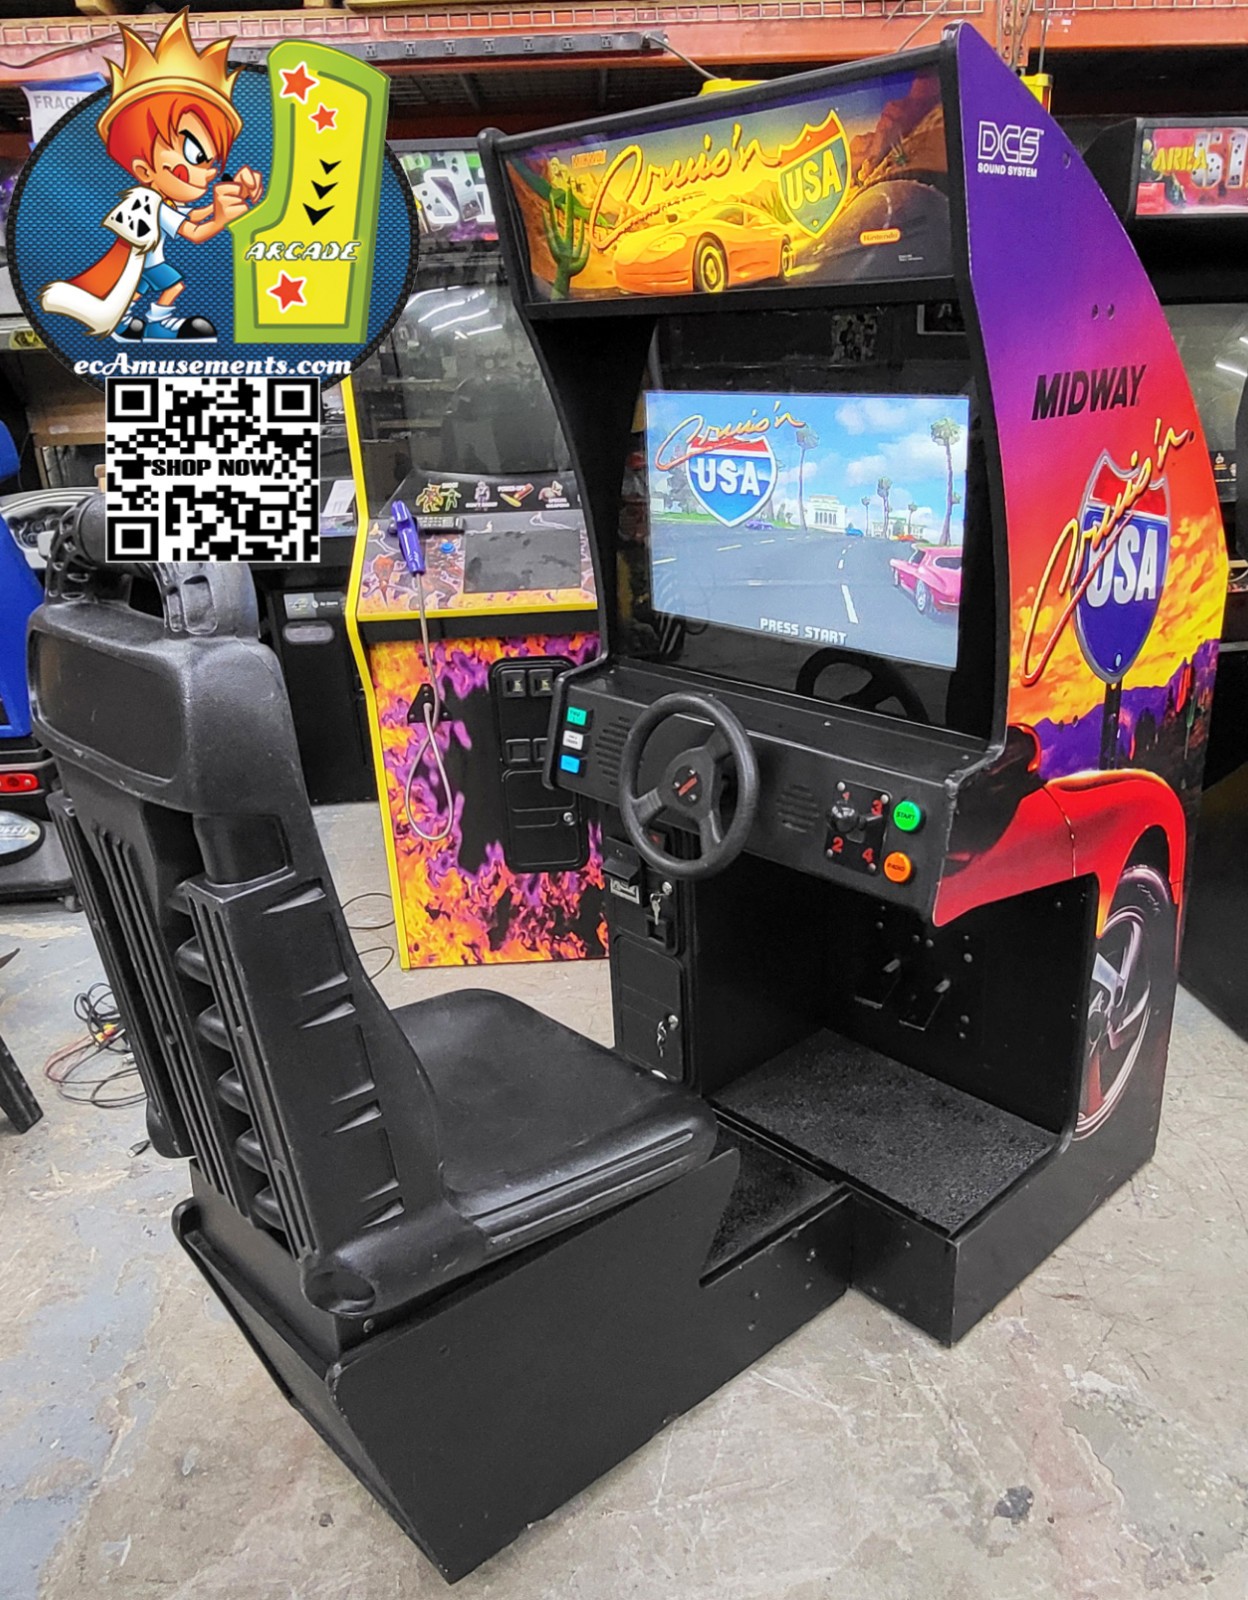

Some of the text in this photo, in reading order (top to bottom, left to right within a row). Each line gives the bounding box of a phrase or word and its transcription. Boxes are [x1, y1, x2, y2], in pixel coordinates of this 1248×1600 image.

[977, 120, 1042, 165] DCS
[977, 162, 1038, 178] SOUND SYSTEM
[1151, 146, 1208, 172] AREA
[1190, 131, 1248, 189] 51
[785, 149, 842, 210] USA
[1031, 364, 1147, 421] MIDWAY
[697, 458, 761, 496] USA
[1085, 523, 1157, 608] USA
[760, 617, 847, 645] PRESS START
[872, 800, 882, 816] 3
[896, 811, 915, 820] START
[832, 837, 843, 853] 2
[862, 848, 874, 863] 4
